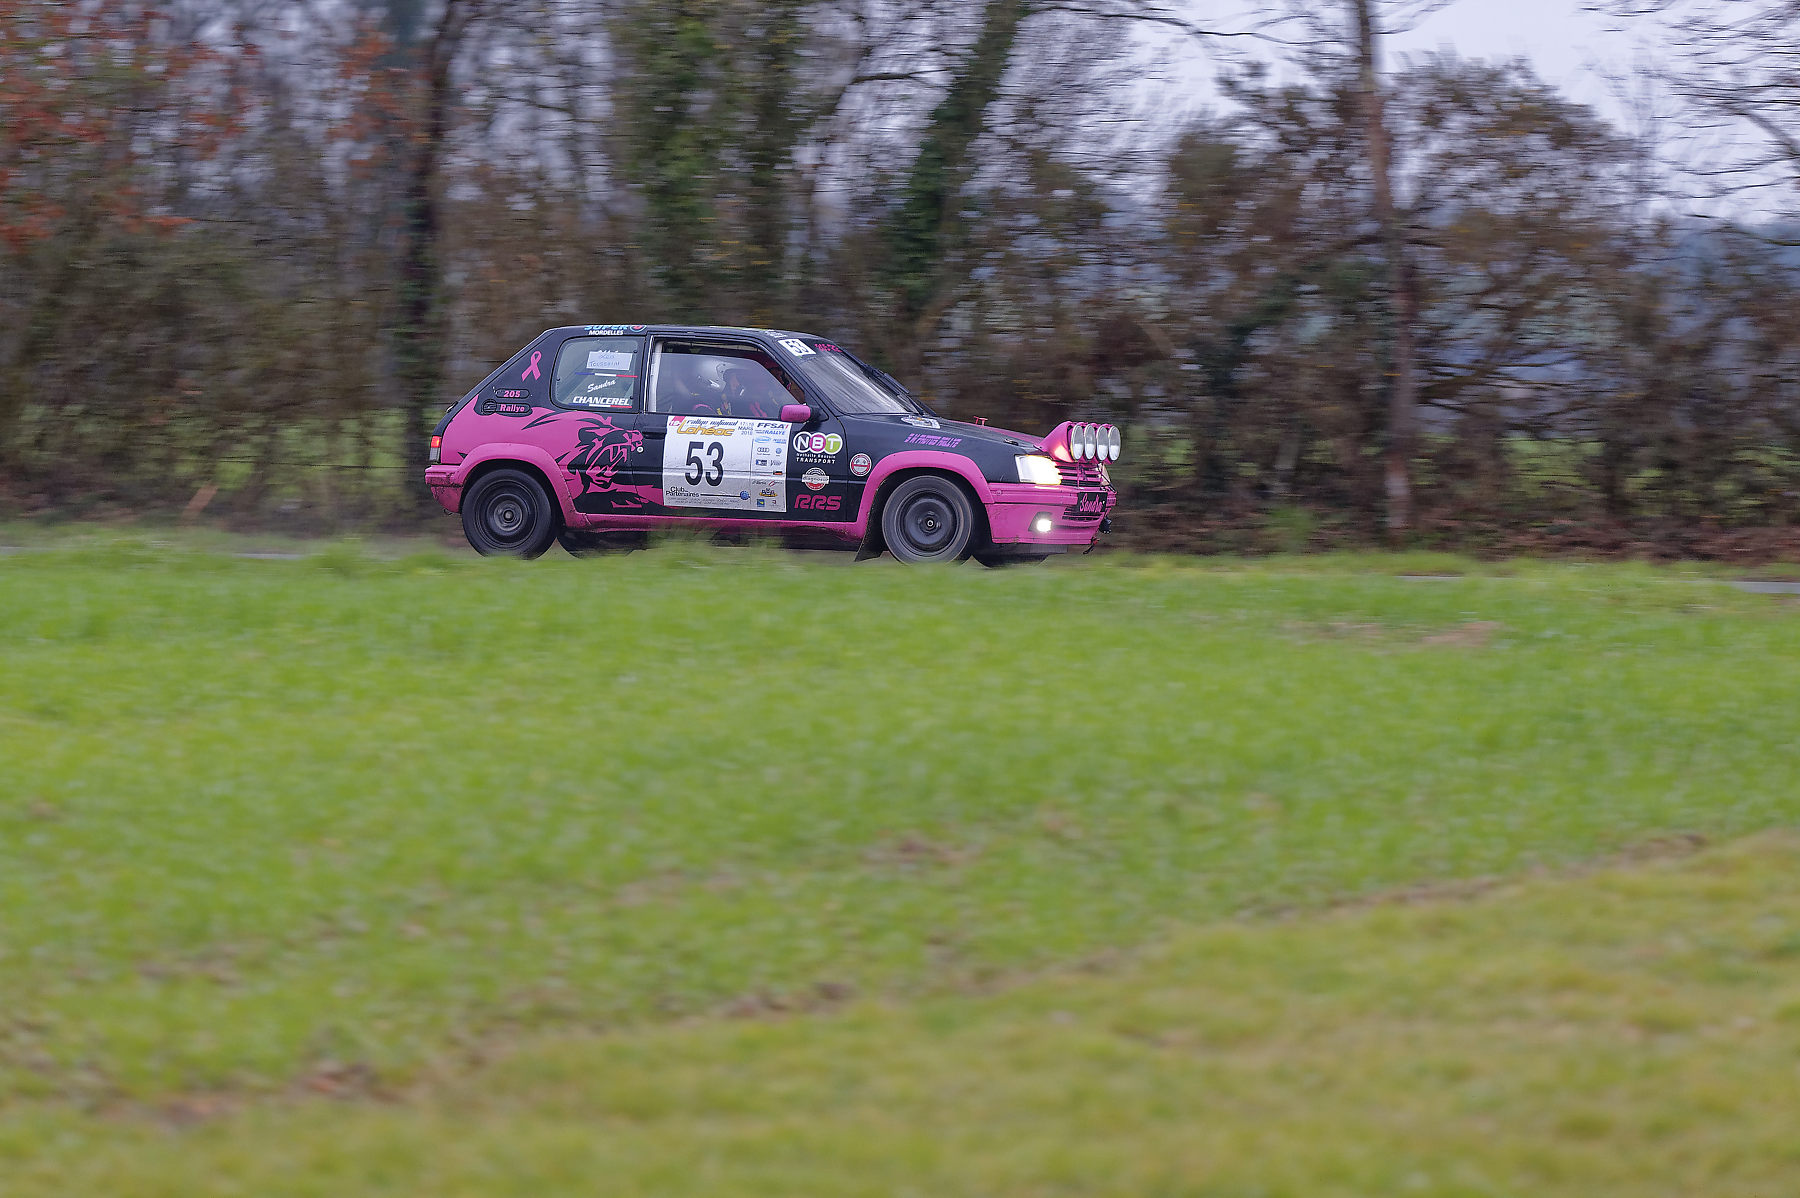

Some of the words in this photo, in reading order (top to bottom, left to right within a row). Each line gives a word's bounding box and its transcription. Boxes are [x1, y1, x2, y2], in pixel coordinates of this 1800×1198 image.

[587, 379, 616, 392] Sandra
[503, 390, 520, 398] 205
[573, 396, 630, 405] CHANCEREL
[796, 435, 841, 450] NBT
[685, 441, 724, 487] 53
[794, 494, 842, 511] RRS
